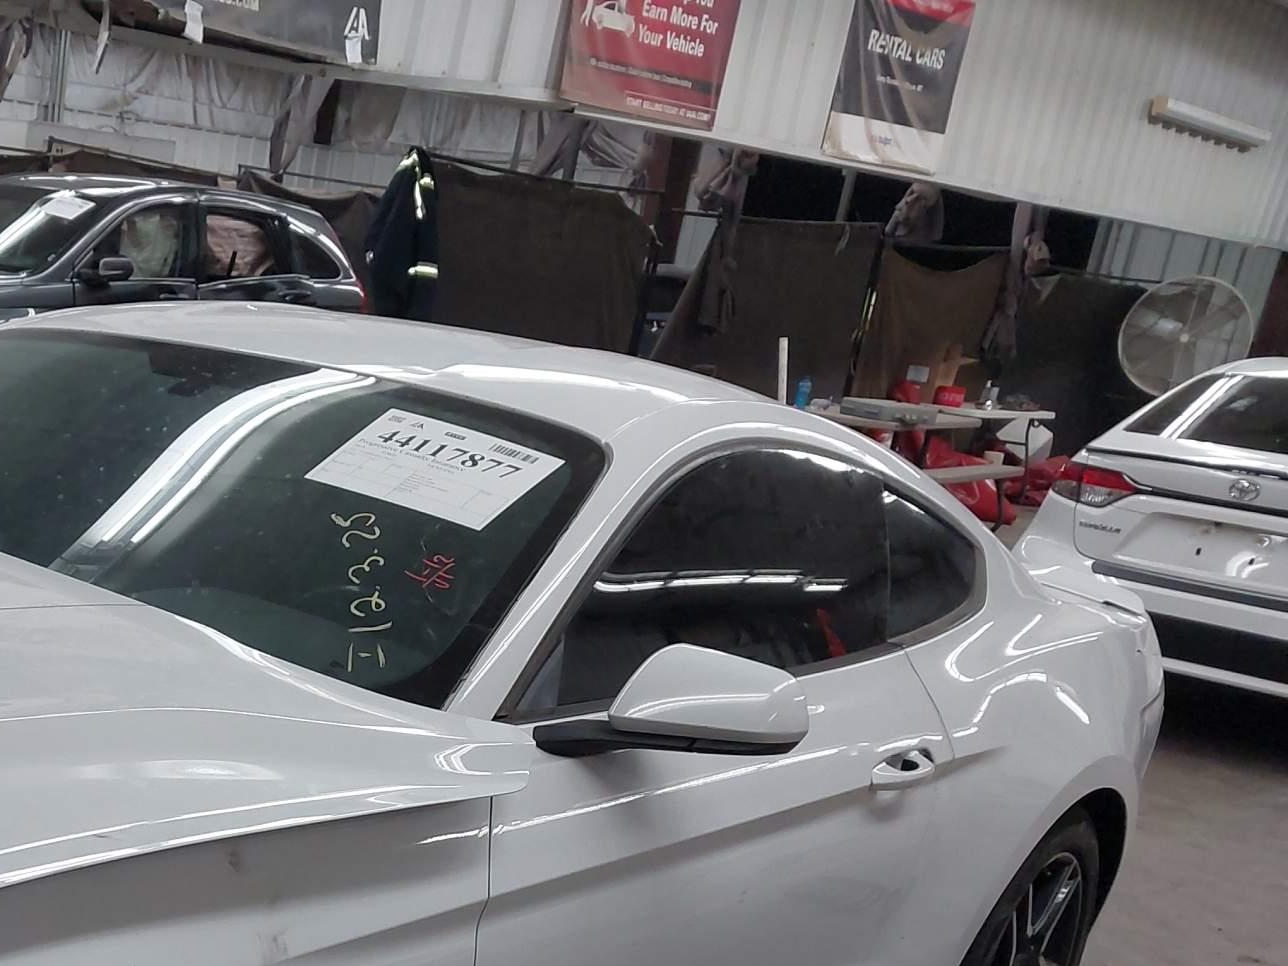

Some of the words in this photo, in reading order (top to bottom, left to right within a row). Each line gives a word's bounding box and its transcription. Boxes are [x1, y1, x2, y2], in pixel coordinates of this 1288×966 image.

[642, 0, 668, 22] Earn
[670, 5, 699, 30] More
[700, 14, 719, 35] For
[638, 24, 663, 49] Your
[665, 30, 705, 57] Vehicle
[867, 29, 913, 62] RENTAL
[915, 47, 946, 70] CARS
[377, 430, 523, 478] 44117877
